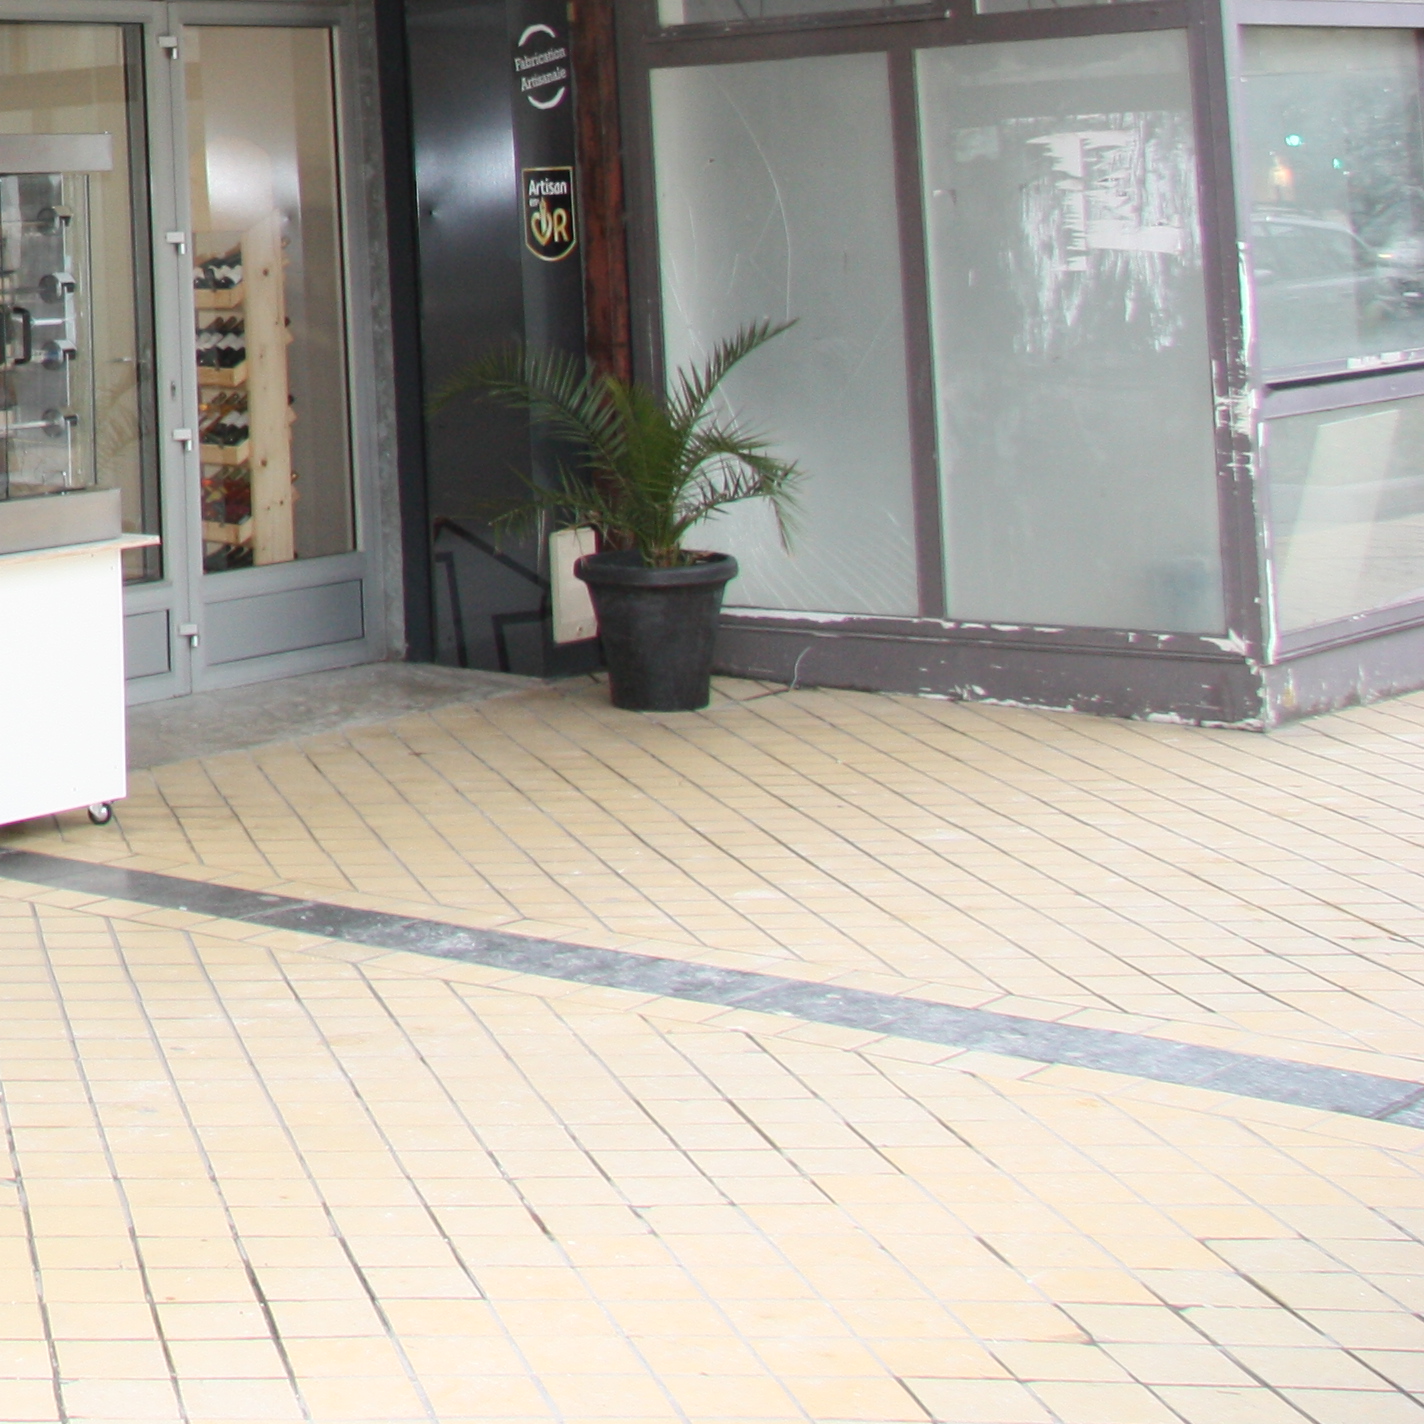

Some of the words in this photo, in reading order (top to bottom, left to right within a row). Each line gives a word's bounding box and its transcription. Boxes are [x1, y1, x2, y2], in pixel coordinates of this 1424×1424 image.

[514, 47, 567, 72] Fabrication
[521, 66, 568, 92] Artisanale
[529, 178, 567, 195] Artisan
